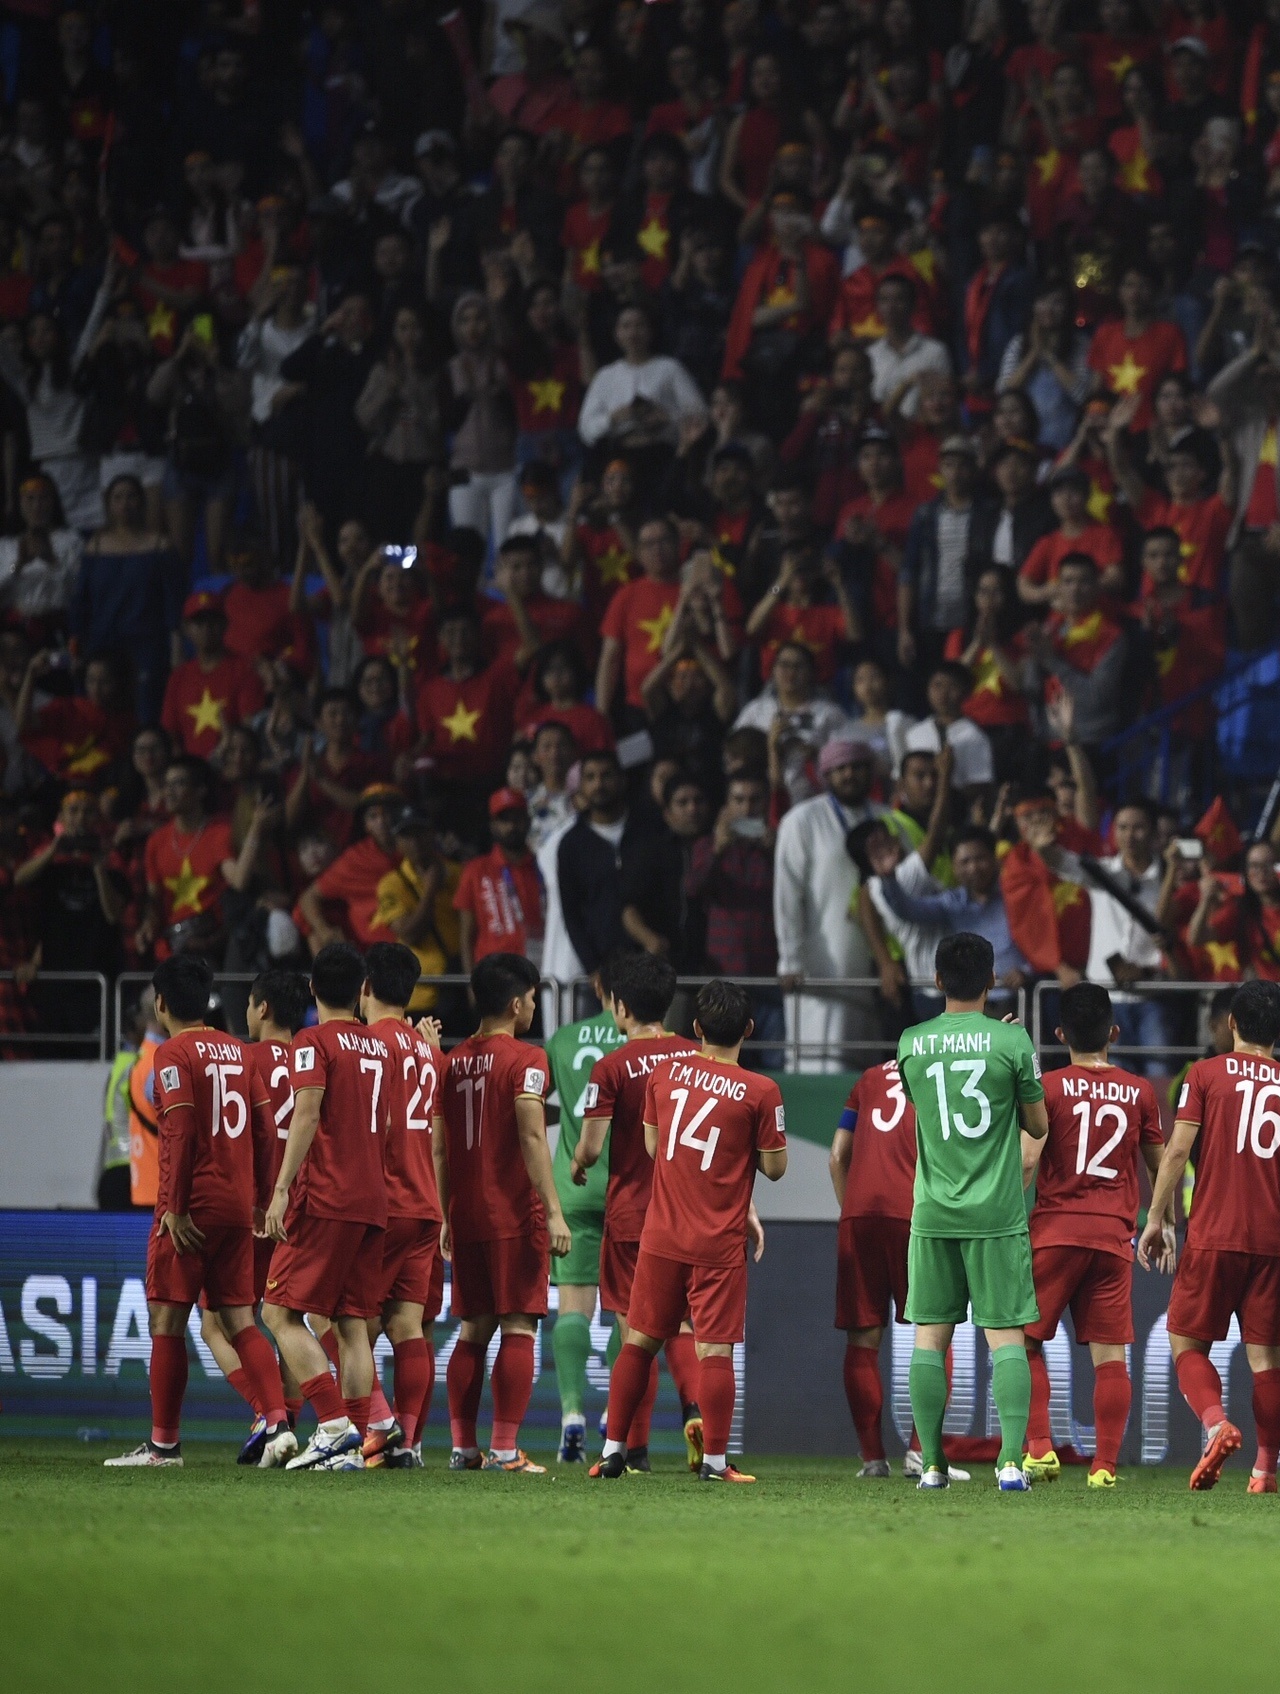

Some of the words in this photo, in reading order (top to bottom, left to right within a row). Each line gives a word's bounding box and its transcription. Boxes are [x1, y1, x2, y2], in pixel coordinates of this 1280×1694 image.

[195, 1041, 243, 1062] P.D.HUY
[451, 1053, 494, 1076] N.V.DAI
[578, 1025, 628, 1044] D.V.LA
[912, 1032, 992, 1057] N.T.MANH
[204, 1063, 248, 1139] 15
[359, 1057, 383, 1134] 7
[456, 1075, 486, 1151] 11
[668, 1061, 748, 1102] T.M.VUONG
[871, 1071, 907, 1133] 3
[925, 1059, 992, 1141] 13
[1062, 1077, 1140, 1106] N.P.H.DUY
[666, 1088, 721, 1172] 14
[1072, 1100, 1128, 1180] 12
[0, 1274, 226, 1379] SIA
